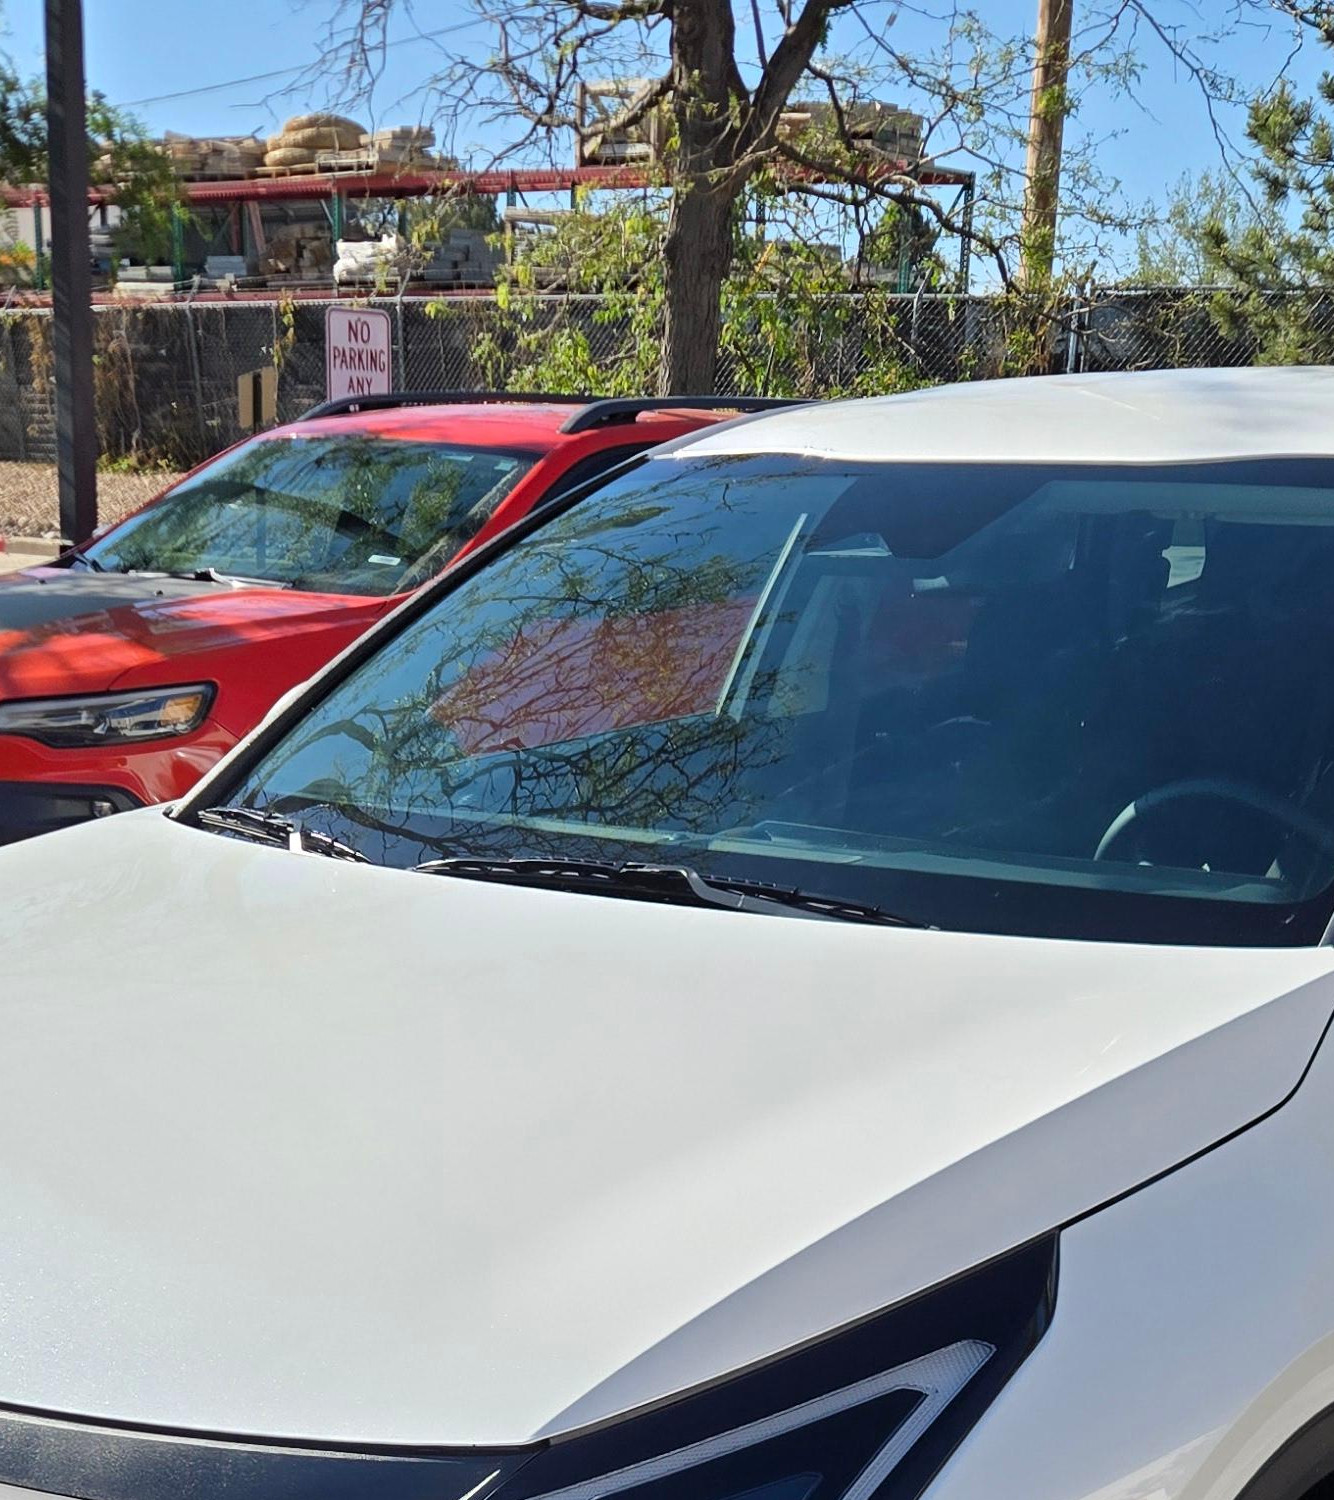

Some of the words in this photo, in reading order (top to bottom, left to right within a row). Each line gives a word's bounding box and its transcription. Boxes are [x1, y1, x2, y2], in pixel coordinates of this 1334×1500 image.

[348, 319, 371, 343] NO
[333, 346, 386, 373] PARKING
[348, 376, 373, 396] ANY
